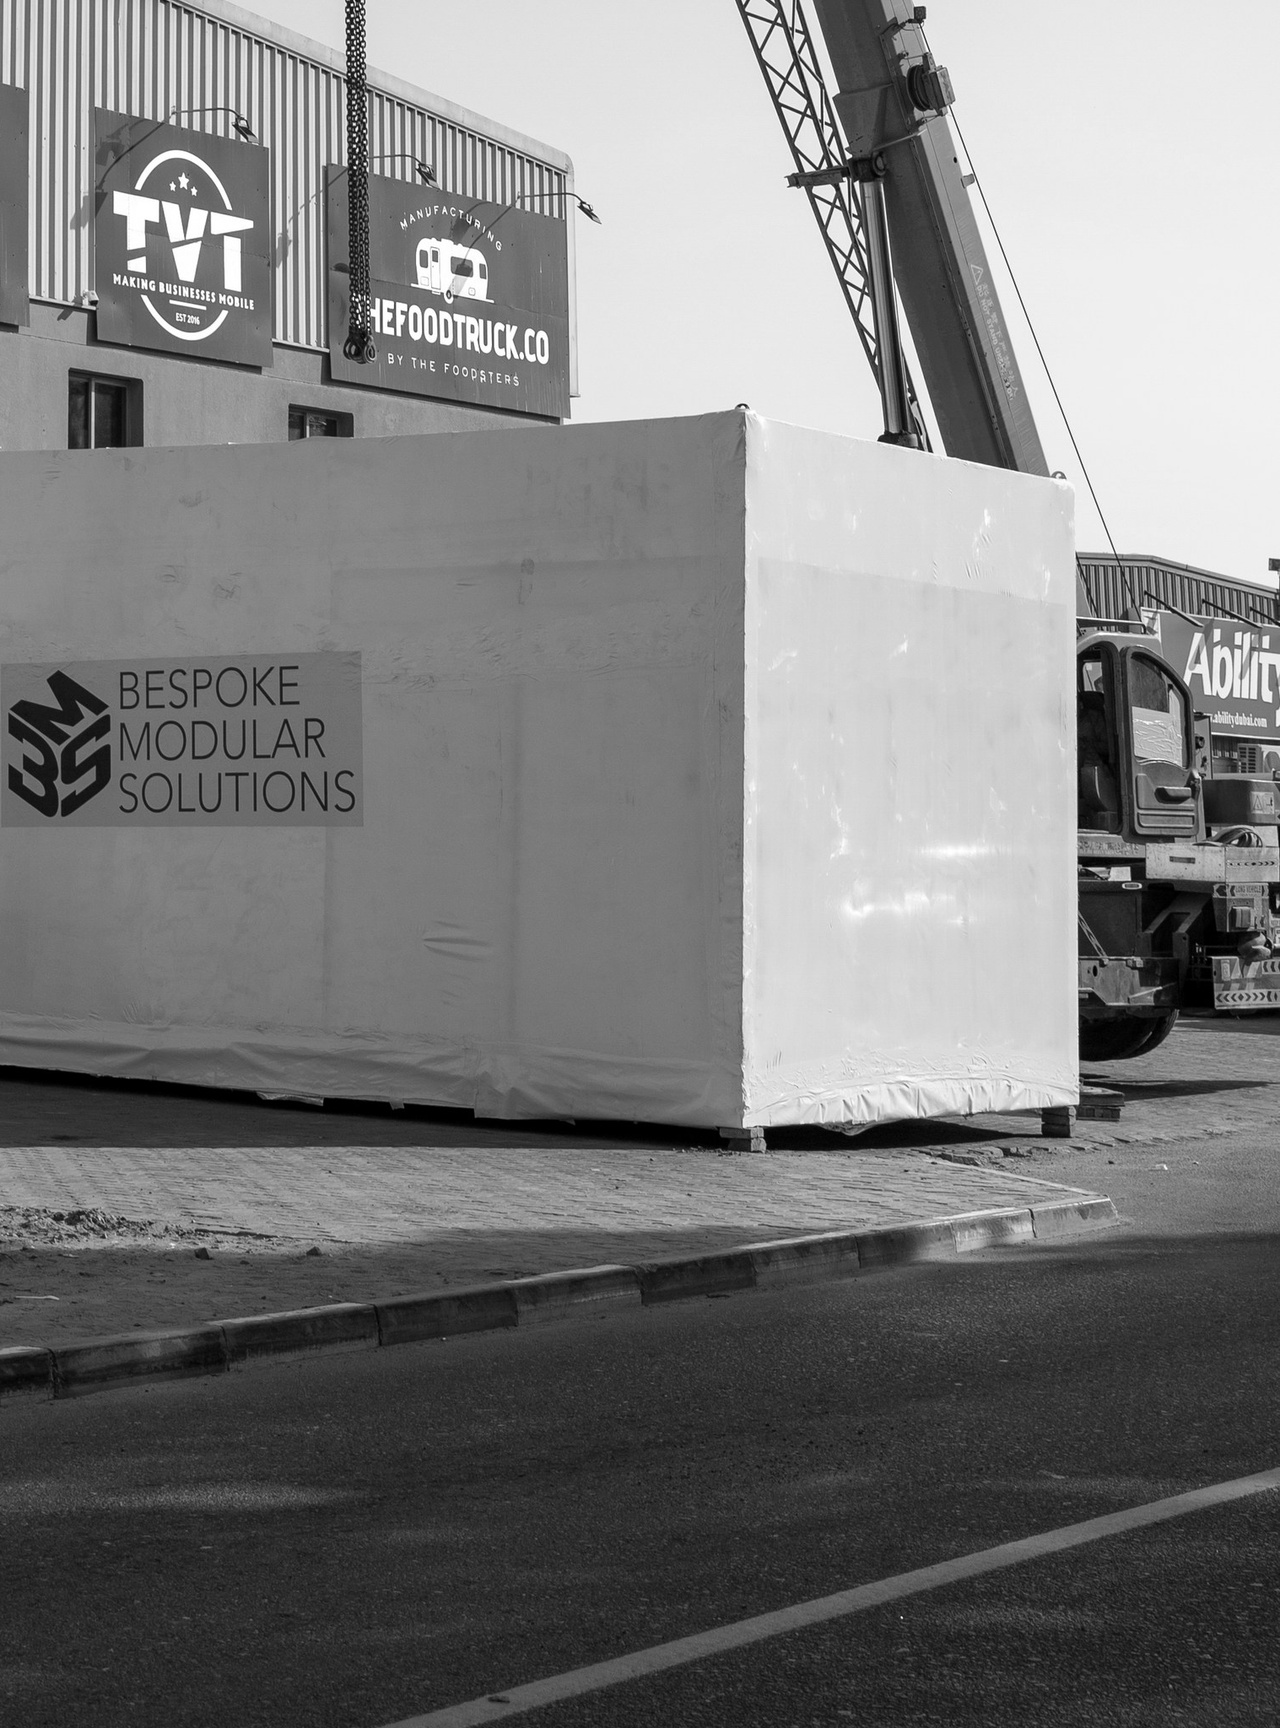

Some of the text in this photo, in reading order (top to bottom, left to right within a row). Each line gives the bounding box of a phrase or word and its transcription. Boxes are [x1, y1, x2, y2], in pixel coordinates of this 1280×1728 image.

[113, 190, 254, 292] TVT
[400, 205, 502, 251] MANUFACTURING
[113, 273, 255, 310] MAKING BUSINESSES MOBILE
[176, 312, 186, 323] EST
[388, 353, 520, 386] BY THE FOODSTERS
[120, 665, 300, 710] BESPOKE
[120, 717, 326, 761] MODULAR
[1194, 709, 1268, 729] .abilitydubai.com
[119, 770, 356, 814] SOLUTIONS
[1235, 885, 1262, 893] LONG VEHICLE
